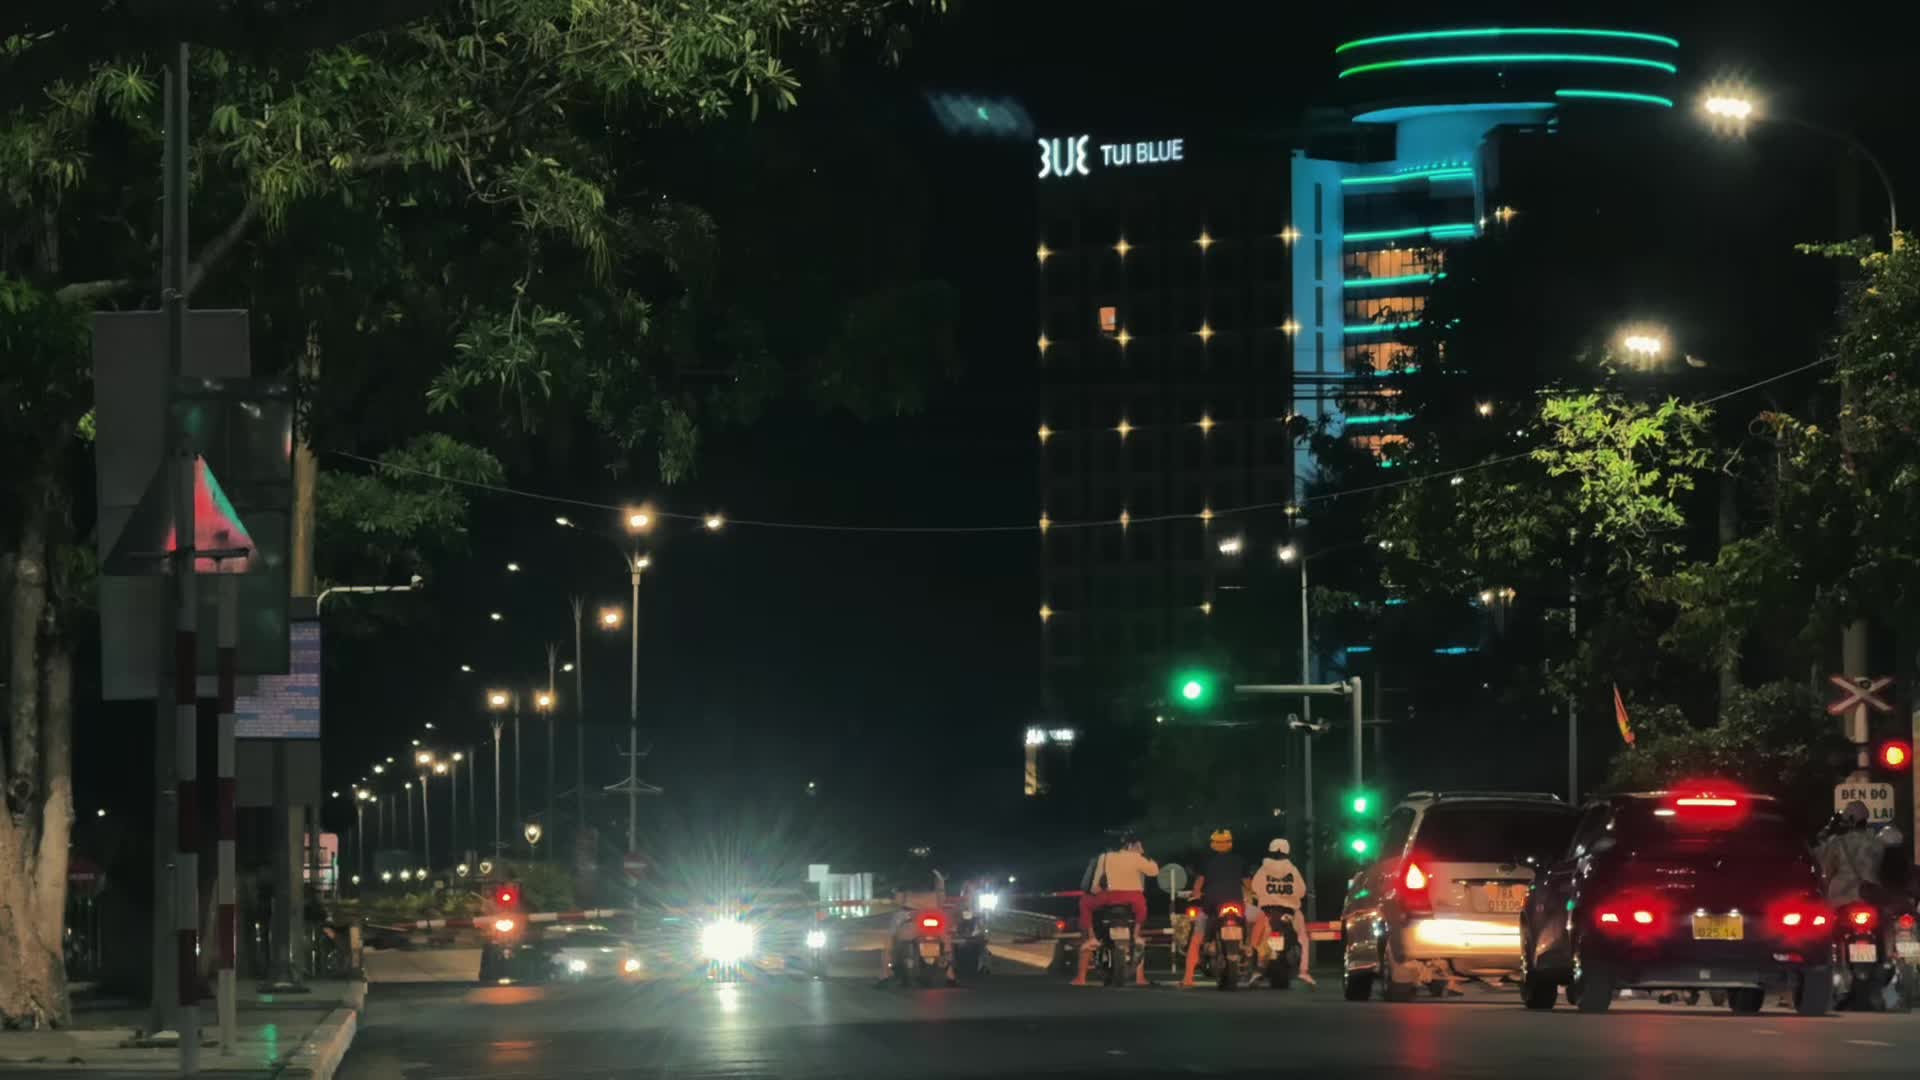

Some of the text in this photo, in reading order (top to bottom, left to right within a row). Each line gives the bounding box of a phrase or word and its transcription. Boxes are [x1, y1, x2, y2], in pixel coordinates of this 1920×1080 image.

[1100, 139, 1184, 166] TUI BLUE
[1266, 884, 1293, 895] CLUB
